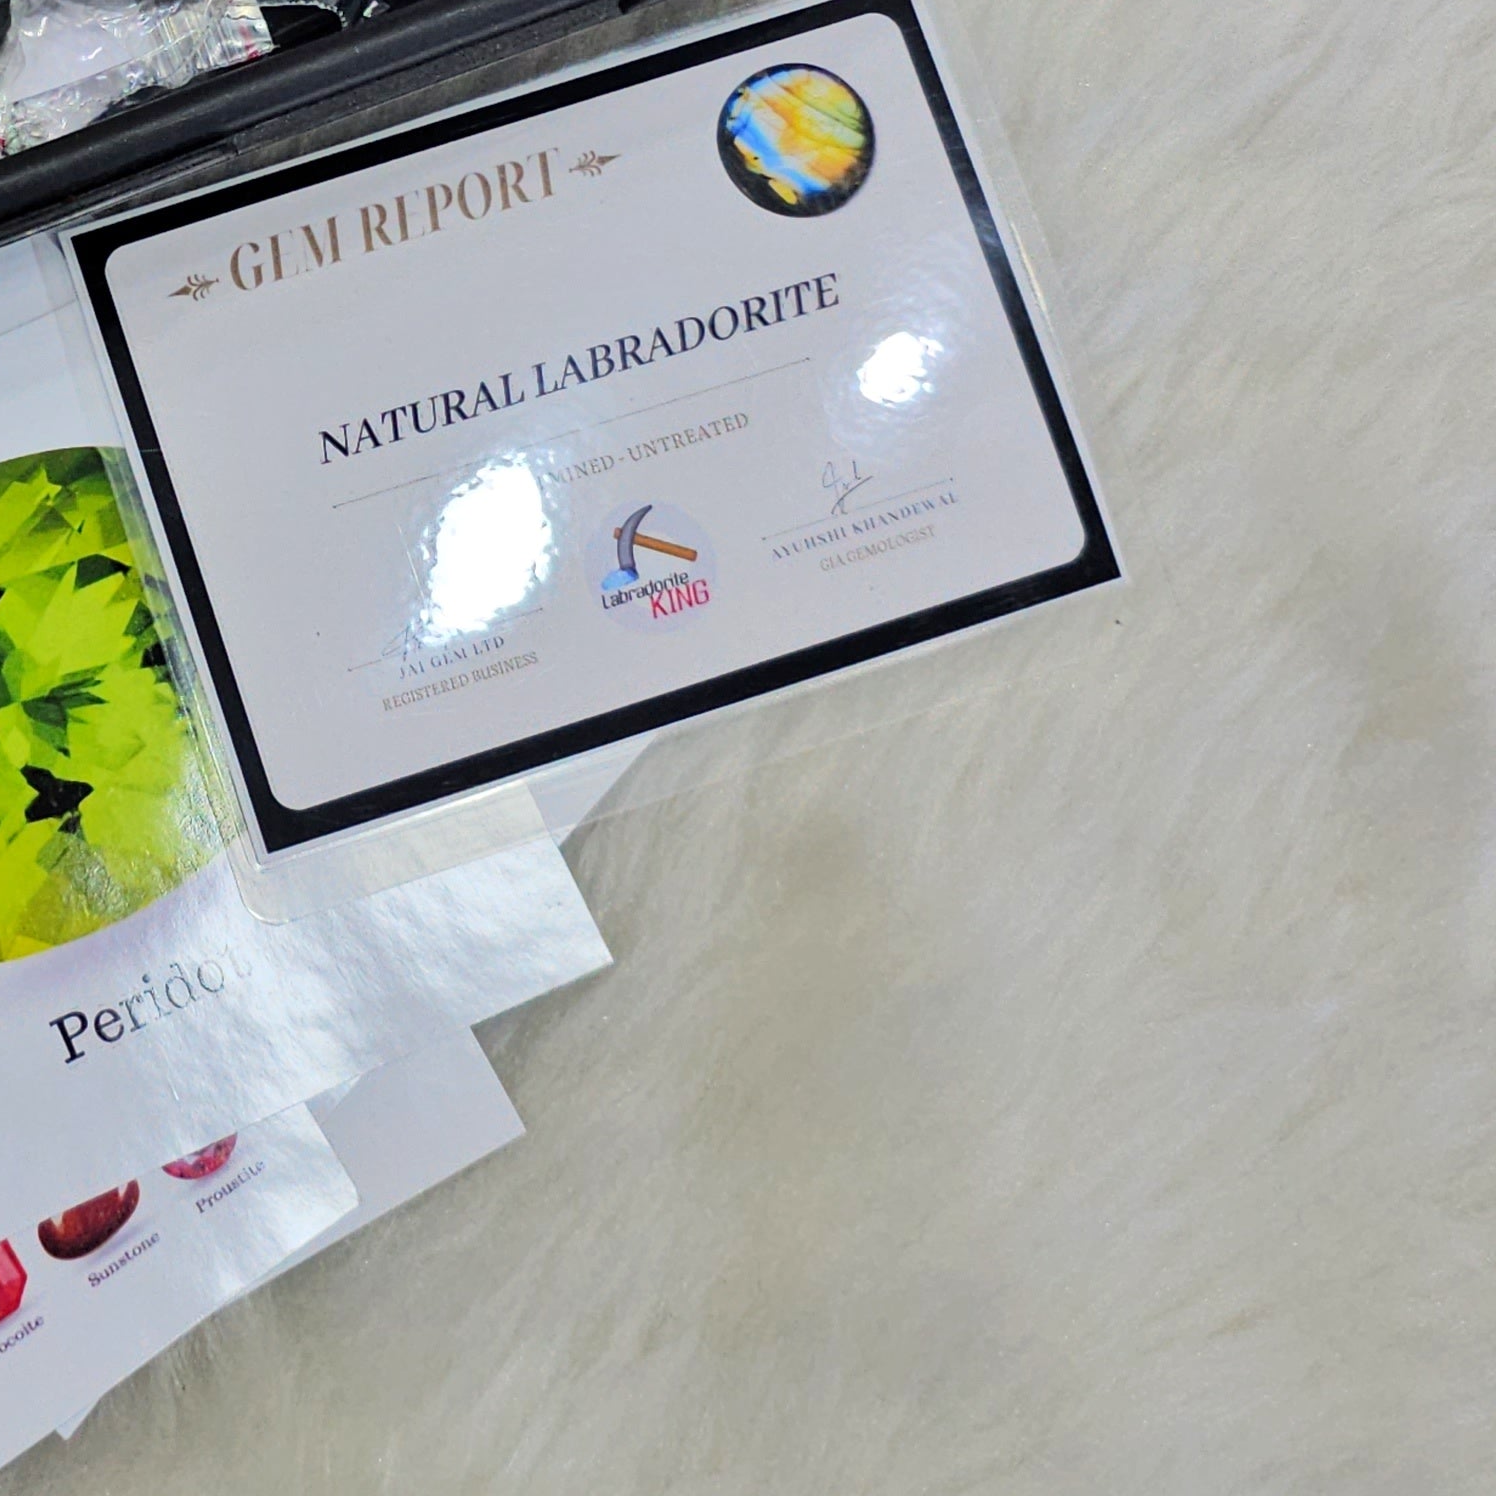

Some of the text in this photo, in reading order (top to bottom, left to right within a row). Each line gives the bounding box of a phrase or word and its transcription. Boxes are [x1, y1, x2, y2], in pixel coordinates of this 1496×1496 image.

[229, 147, 560, 292] GEM REPORT
[318, 273, 840, 464] NATURAL LABRADORITE
[626, 412, 750, 462] UNTREATED
[846, 524, 937, 564] GEMOLOGIST
[601, 571, 690, 610] Labradorite
[649, 578, 710, 619] KING
[472, 635, 505, 656] LTD
[381, 651, 540, 712] REGISTERED BUSINESS
[194, 1160, 266, 1215] Proustite
[87, 1231, 161, 1288] Sunstone
